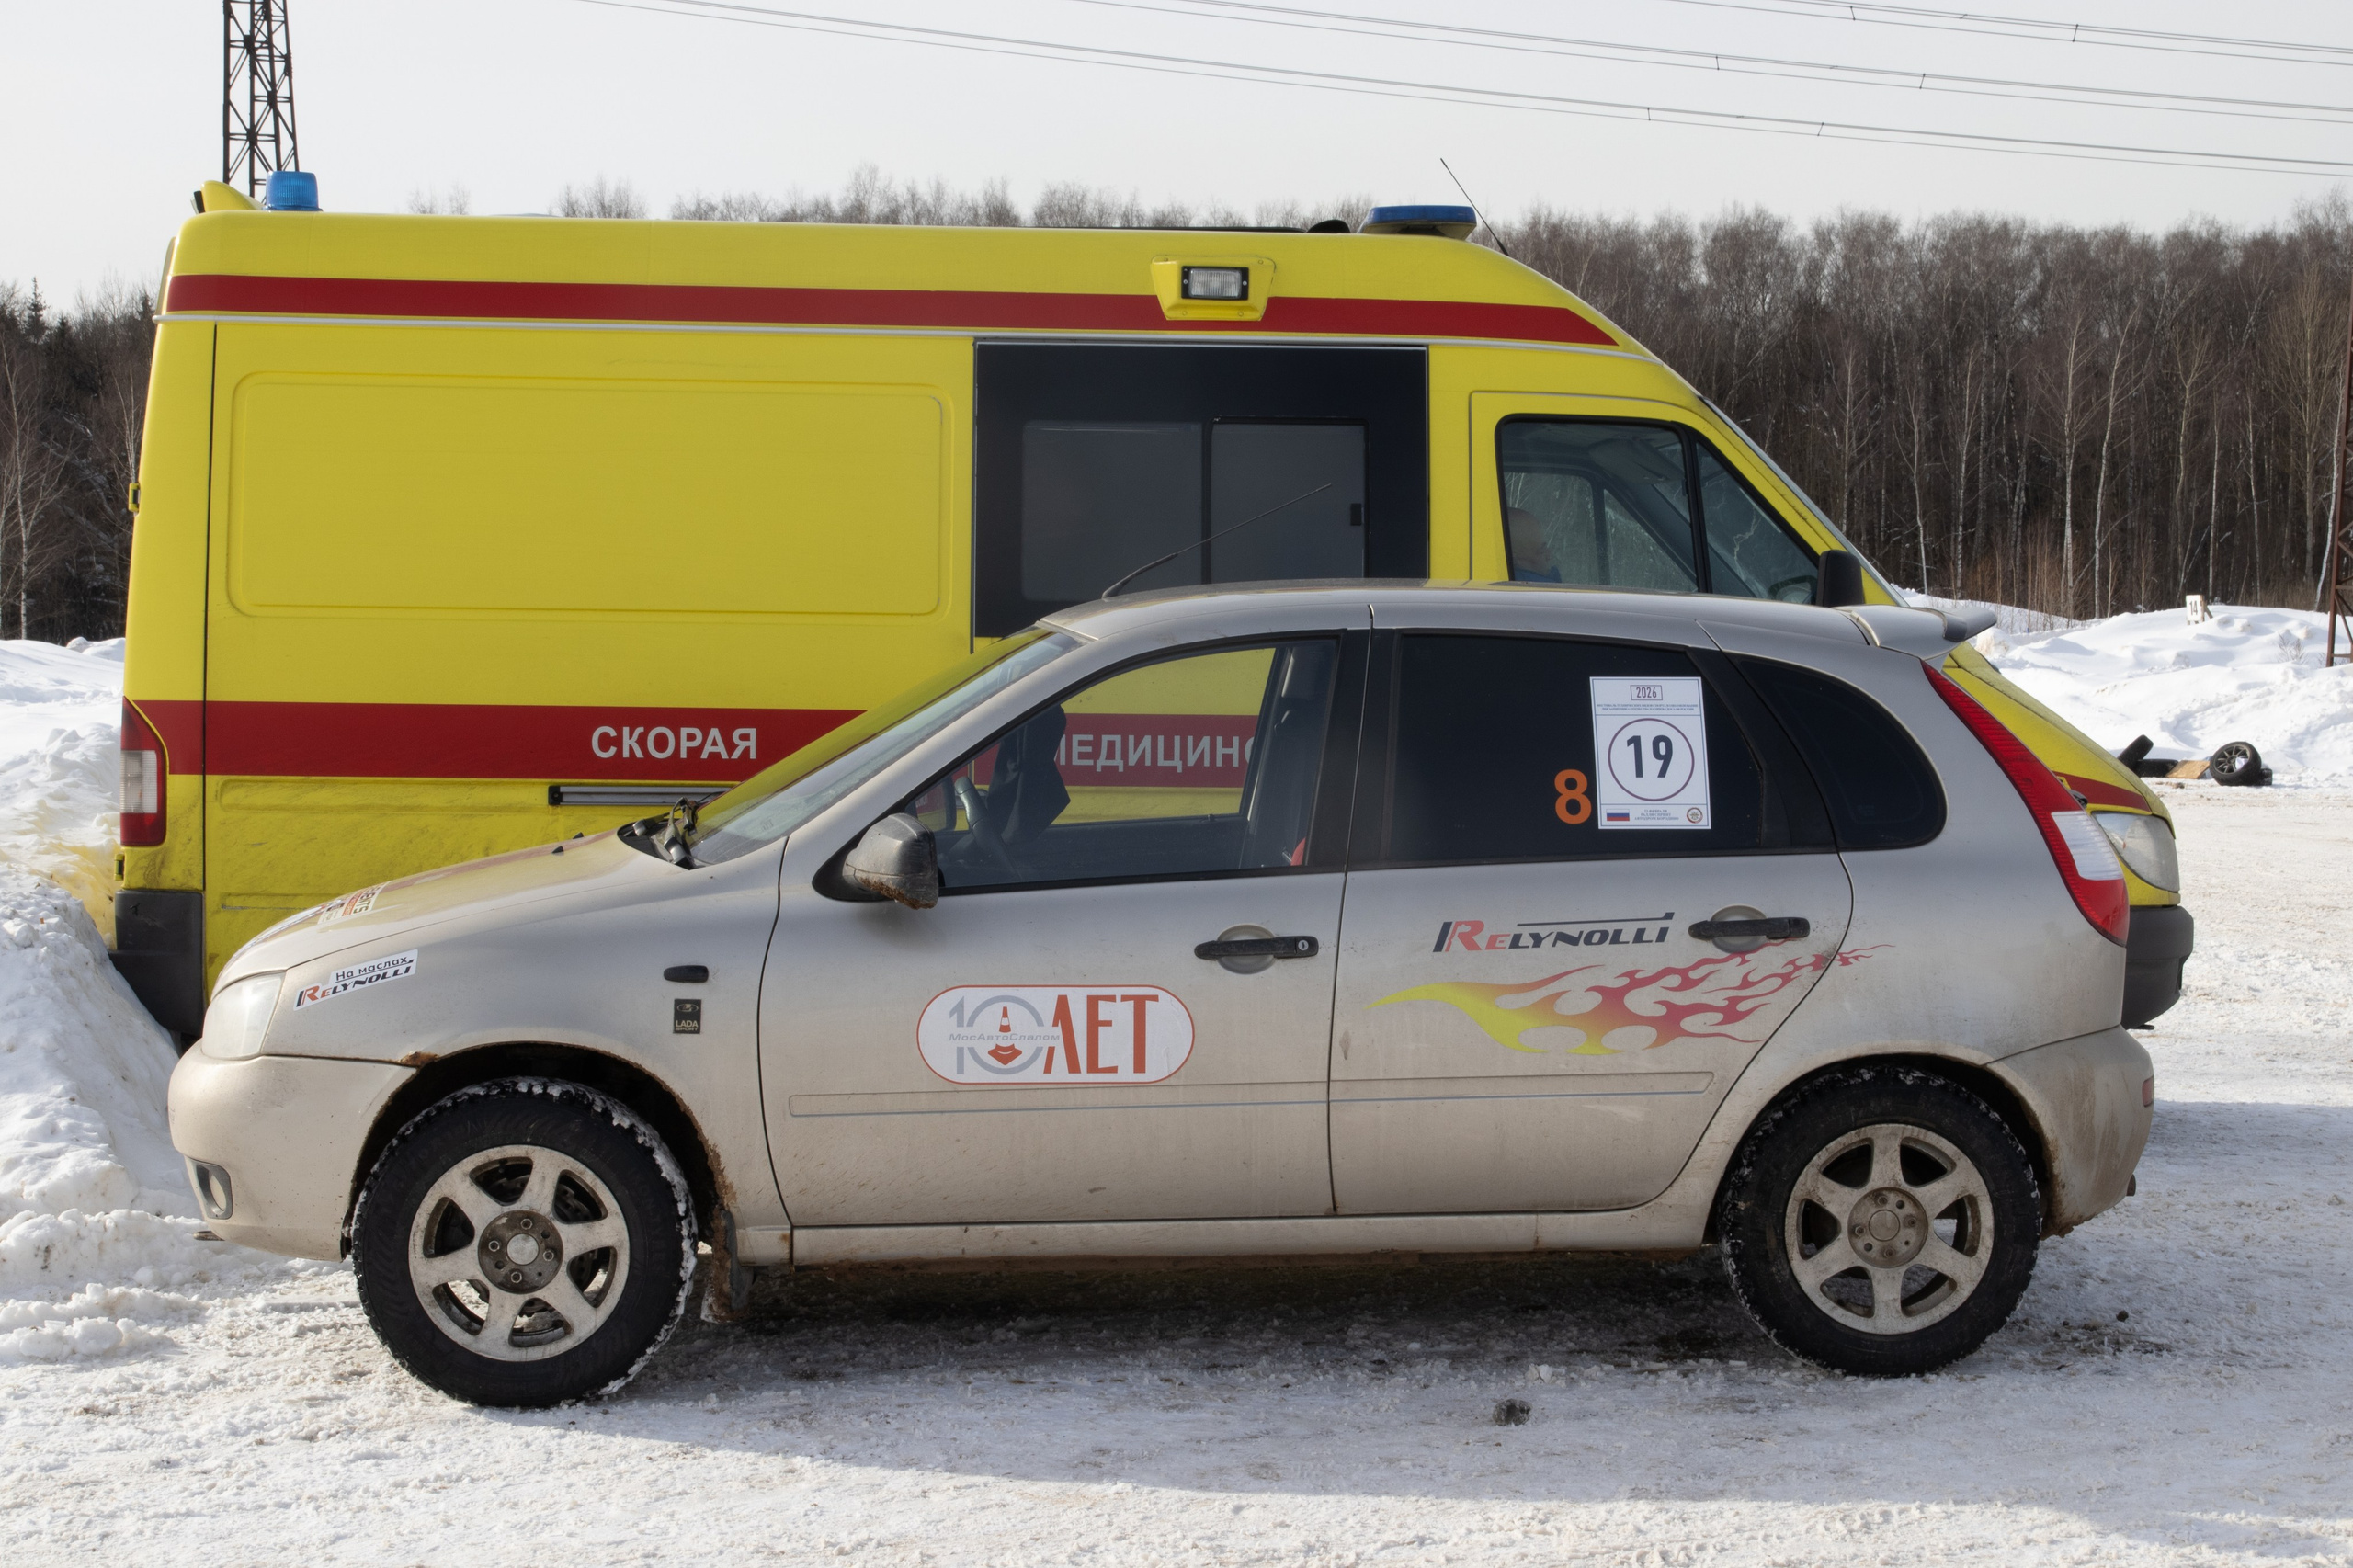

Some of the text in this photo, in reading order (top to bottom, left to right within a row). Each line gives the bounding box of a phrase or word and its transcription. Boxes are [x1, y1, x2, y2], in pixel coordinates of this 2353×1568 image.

[2189, 600, 2198, 615] 14
[1636, 687, 1657, 699] 2026
[591, 726, 758, 761] СКОРАЯ
[1626, 734, 1673, 778] 19
[1554, 769, 1592, 824] 8
[1433, 919, 1670, 953] RELYNOLLI
[335, 956, 408, 982] На маслах
[296, 965, 412, 1008] RELYNOLLI
[676, 1019, 698, 1028] LADA
[949, 994, 1159, 1075] 10 ЛЕТ
